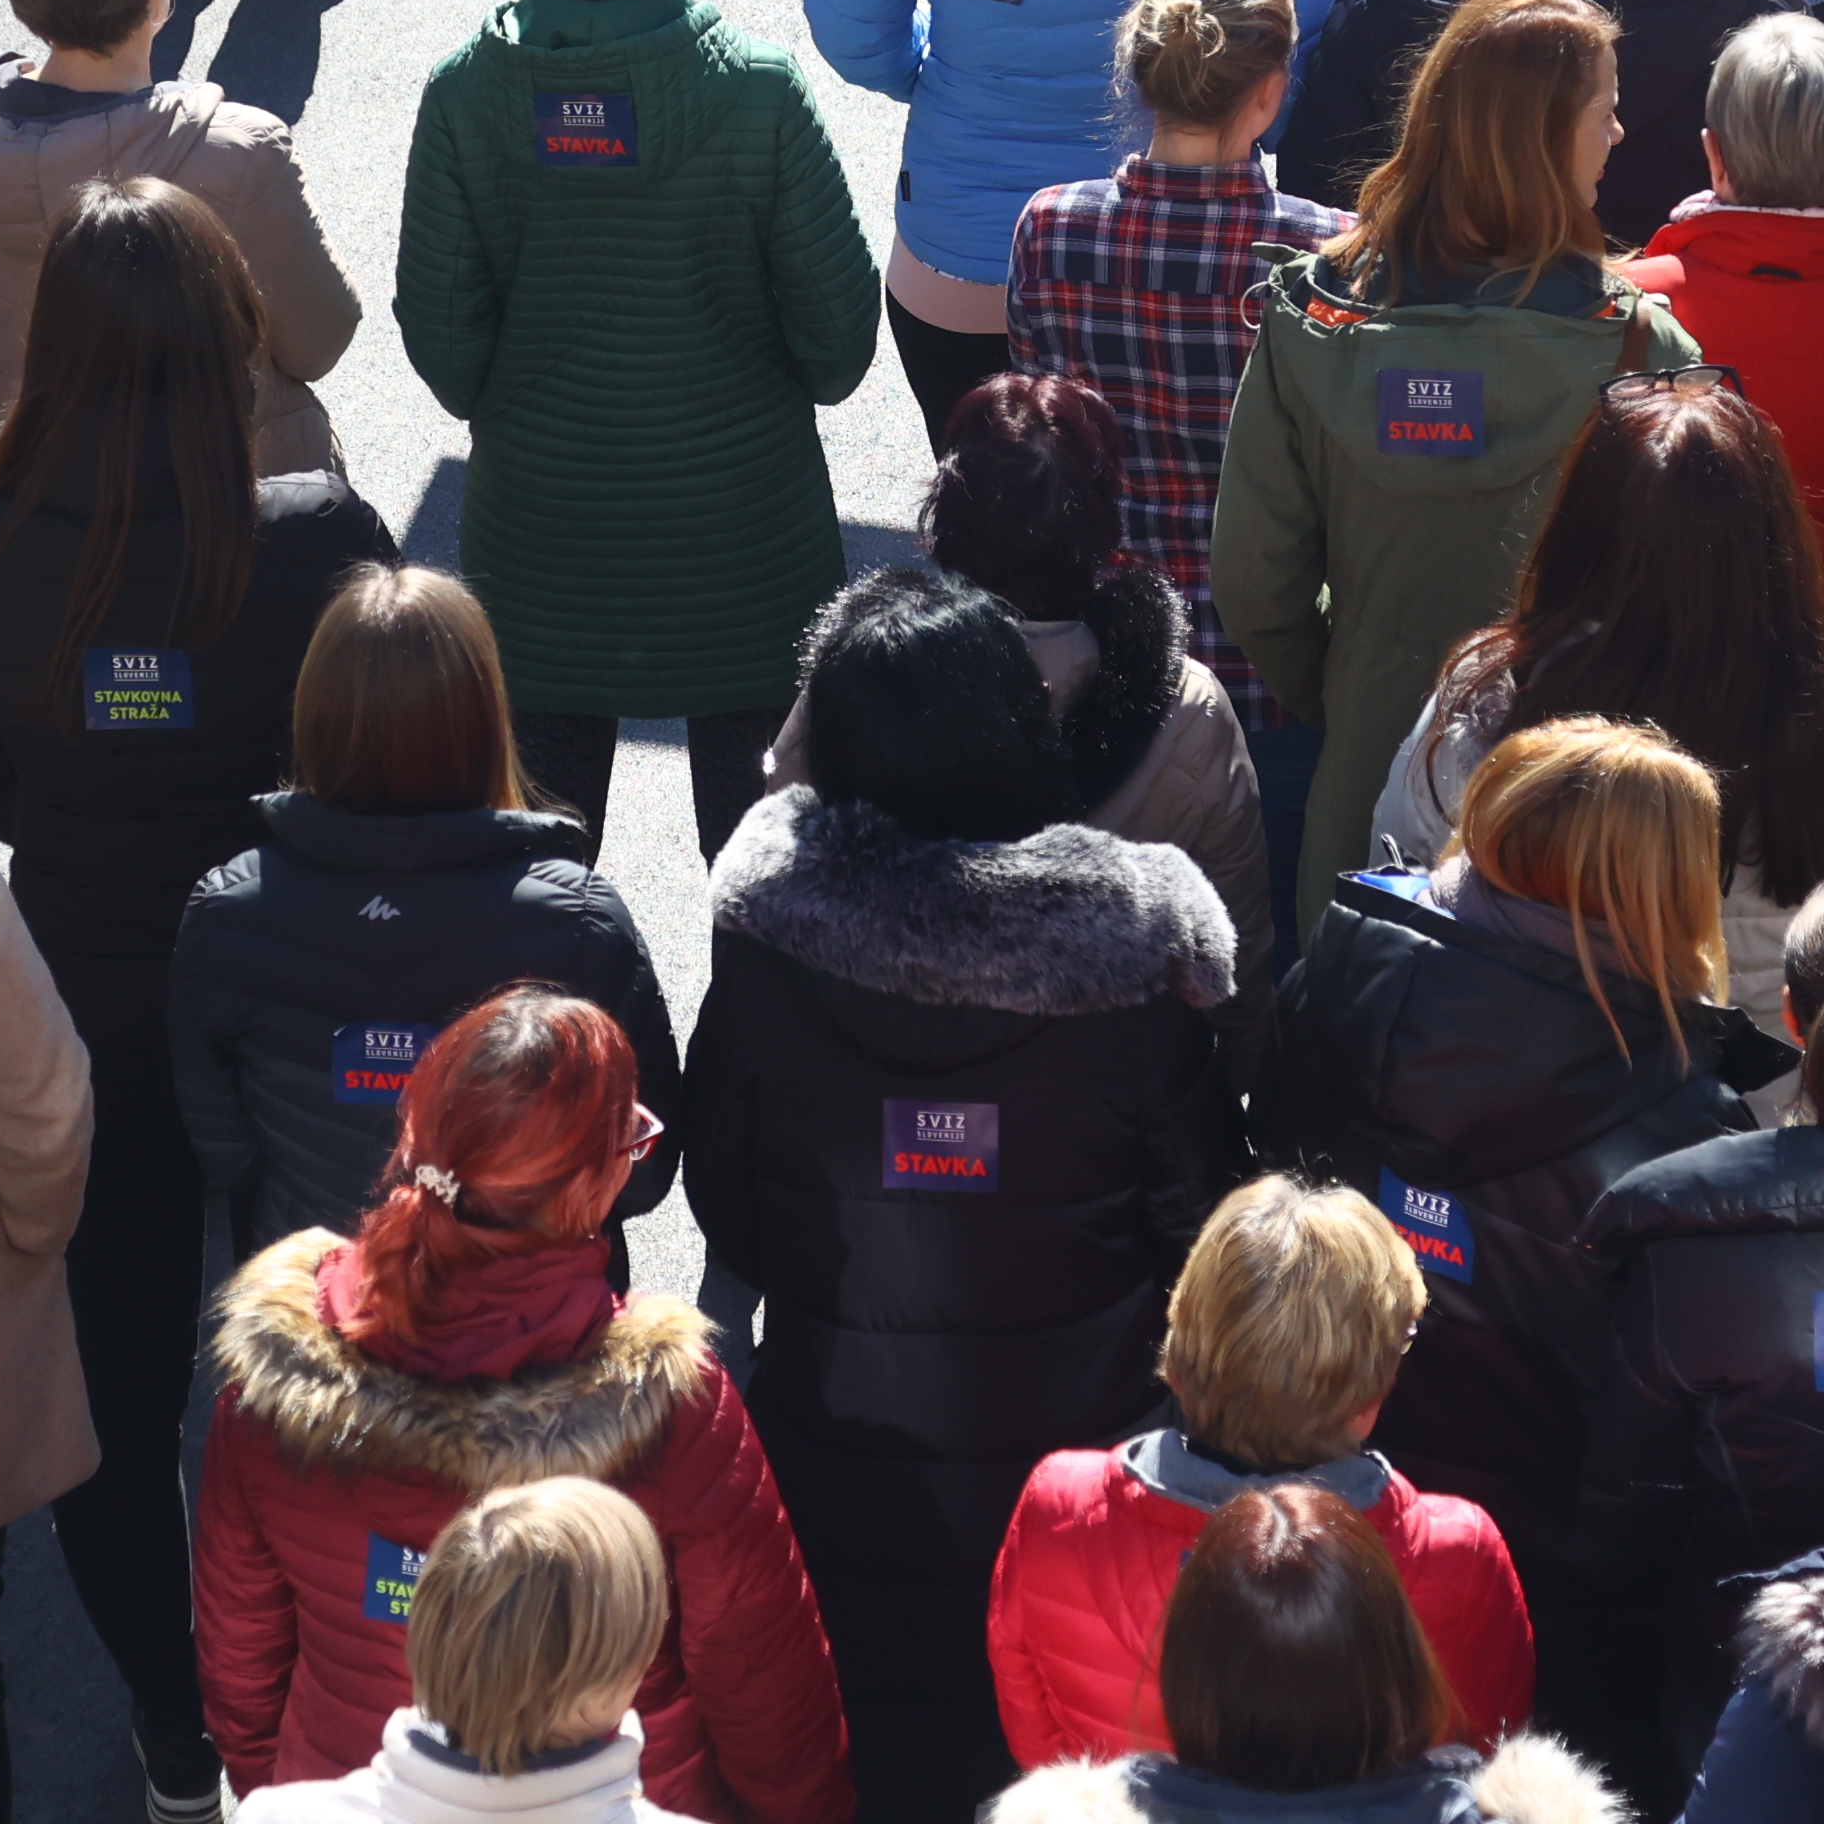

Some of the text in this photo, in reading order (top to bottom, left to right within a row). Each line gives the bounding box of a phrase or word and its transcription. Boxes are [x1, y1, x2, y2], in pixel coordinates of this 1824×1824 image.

[562, 104, 605, 115] SVIZ
[546, 137, 626, 154] STAVKA
[1407, 382, 1452, 396] SVIZ
[1407, 398, 1453, 406] SLOVENIJE
[1388, 421, 1474, 442] STAVKA
[112, 657, 158, 669] SVIZ
[94, 690, 182, 703] STAVKOVNA
[109, 703, 170, 719] STRAŽA
[365, 1033, 414, 1048] SVIZ
[344, 1070, 410, 1090] STAV
[917, 1114, 965, 1129] SVIZ
[916, 1131, 965, 1139] SLOVENIJE
[894, 1151, 988, 1177] STAVKA
[1405, 1188, 1450, 1215] SVIZ
